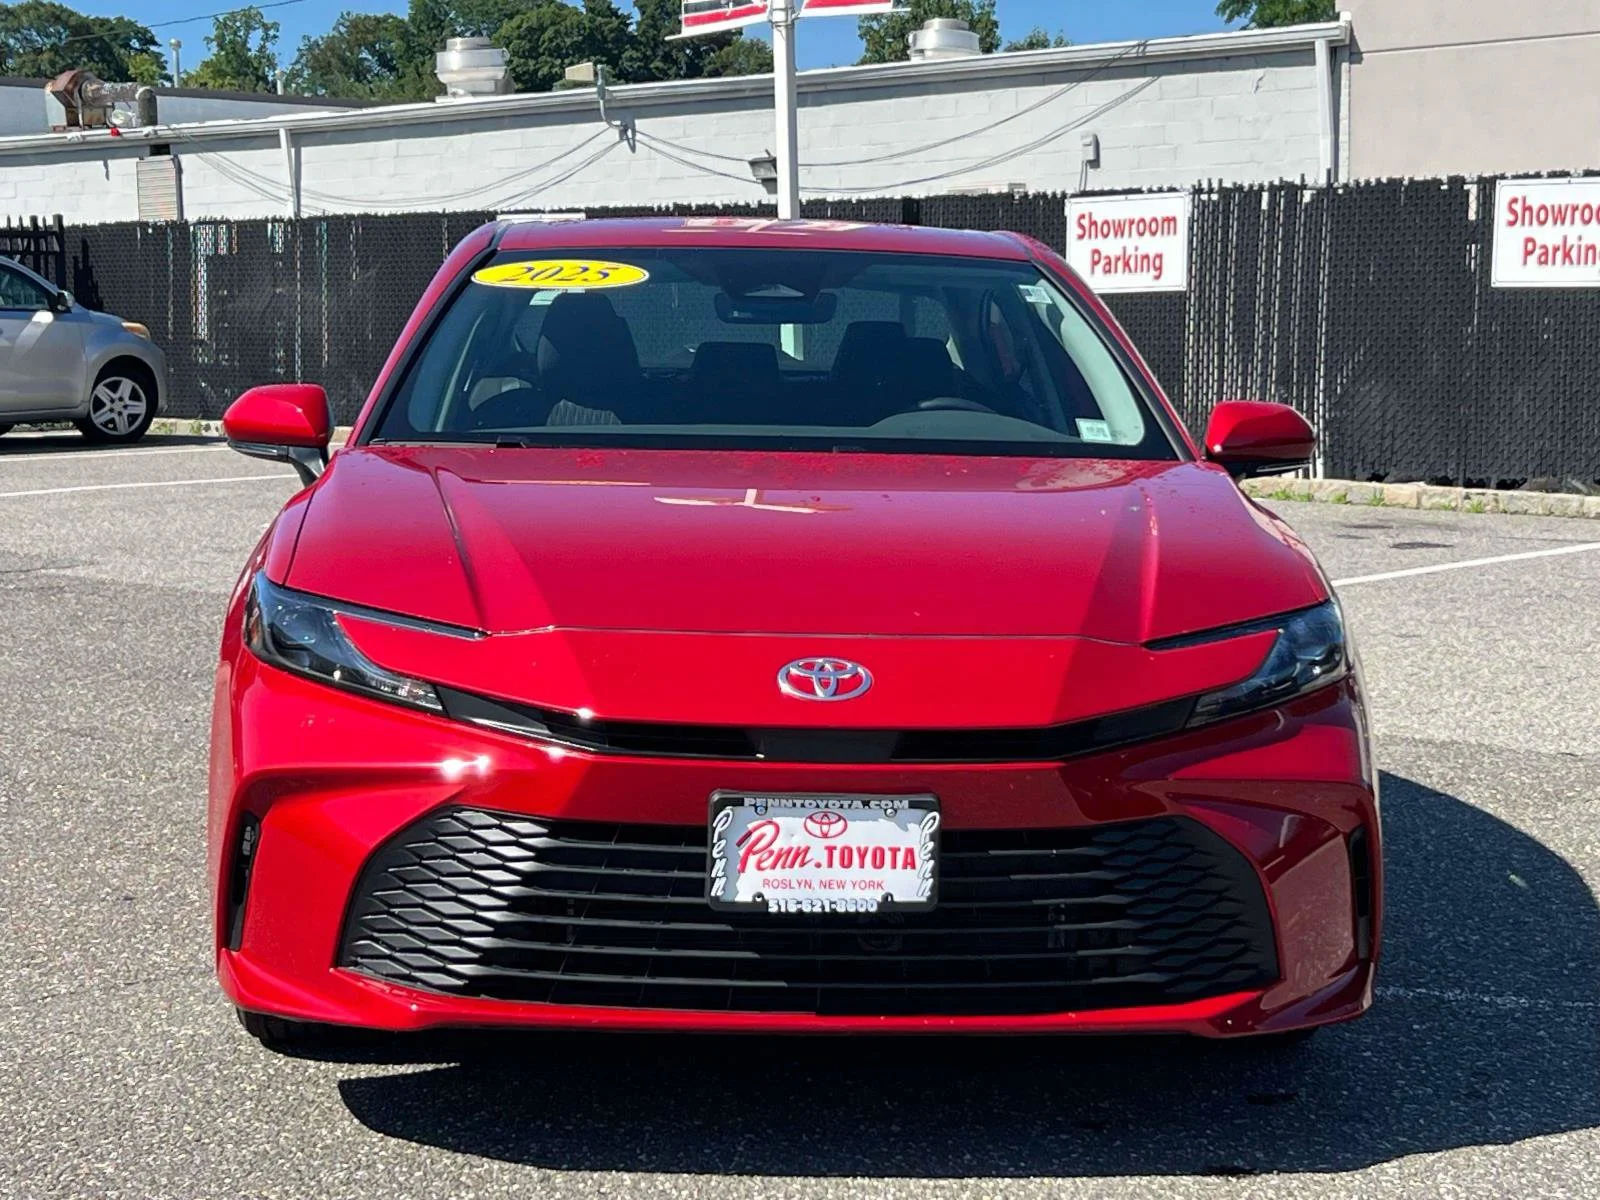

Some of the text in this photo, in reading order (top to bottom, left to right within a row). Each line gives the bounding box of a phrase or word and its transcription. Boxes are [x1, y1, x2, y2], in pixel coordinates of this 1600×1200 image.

[1076, 212, 1177, 241] Showroom
[1090, 245, 1163, 281] Parking
[1523, 234, 1600, 267] Parkin
[498, 265, 620, 282] 2025
[743, 797, 909, 809] PENNTOYOTA.COM
[711, 806, 733, 897] Penn
[824, 845, 916, 870] TOYOTA
[917, 811, 940, 897] Penn
[762, 878, 885, 891] ROSLYN, NEW YORK
